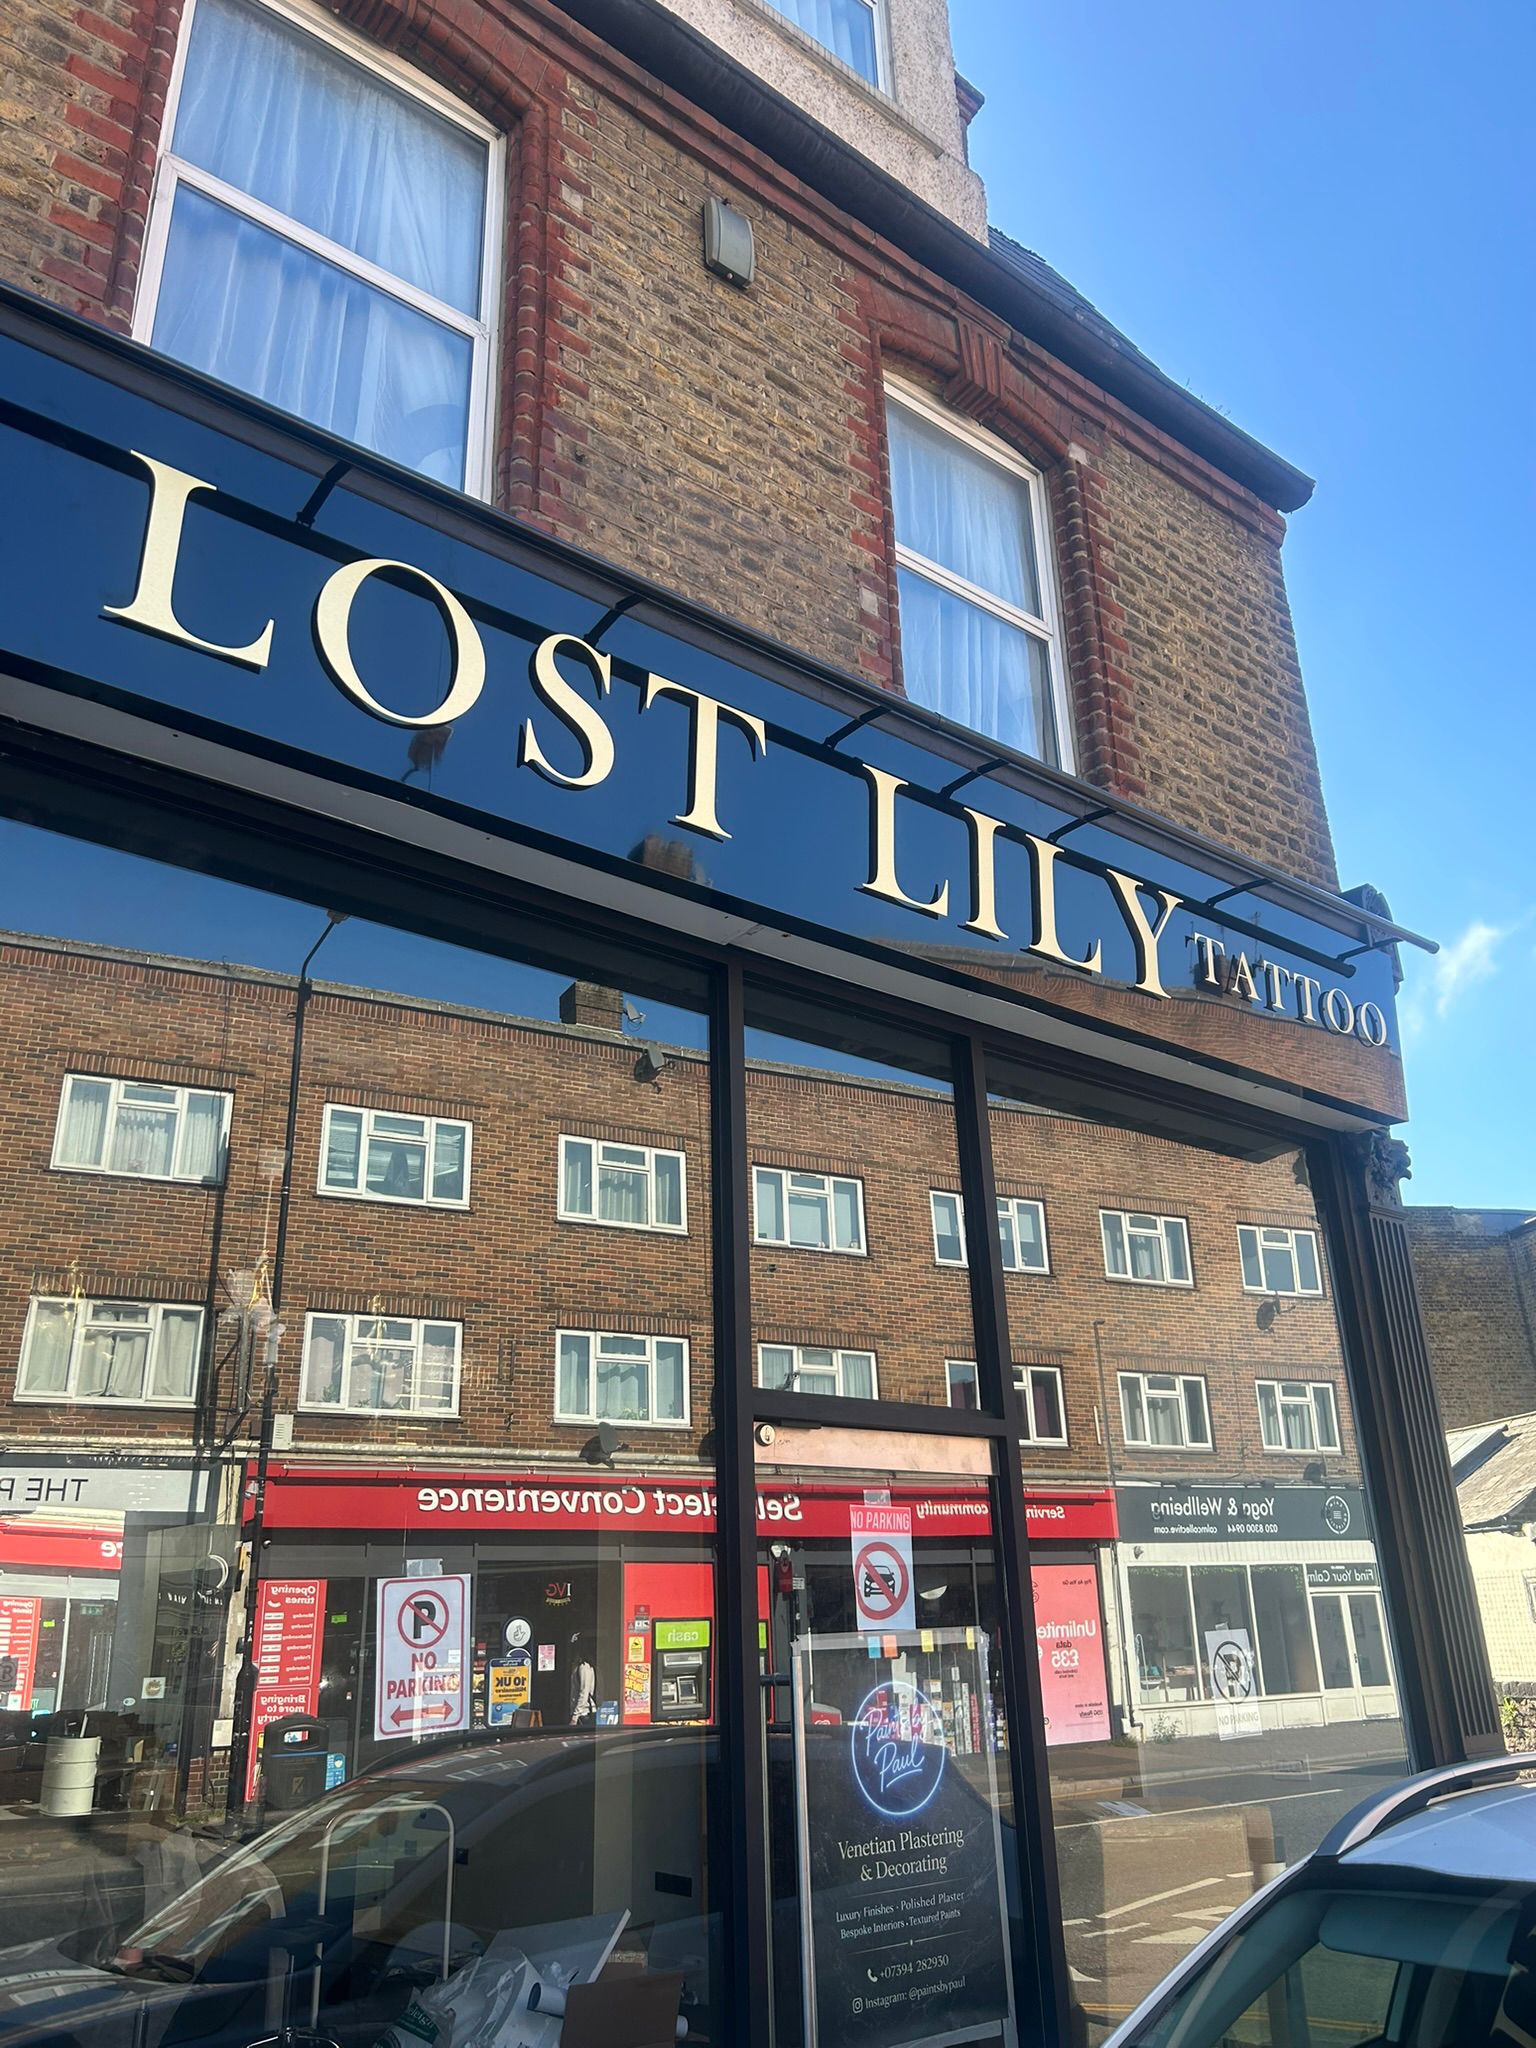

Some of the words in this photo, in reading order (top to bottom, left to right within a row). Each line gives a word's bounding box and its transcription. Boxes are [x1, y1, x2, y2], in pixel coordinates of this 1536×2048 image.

[103, 450, 766, 840] LOST
[858, 764, 1183, 999] LILY
[1192, 931, 1388, 1048] TATTOO
[850, 1510, 863, 1530] NO
[865, 1511, 911, 1531] PARKING
[411, 1651, 437, 1672] NO
[387, 1673, 461, 1700] PARKING
[874, 1732, 925, 1793] Paul
[837, 1836, 896, 1860] Venetian
[899, 1826, 965, 1851] Plastering
[860, 1863, 873, 1882] &
[876, 1854, 948, 1880] Decorating
[836, 1909, 862, 1923] Luxury
[863, 1903, 894, 1918] Finishes
[900, 1894, 936, 1911] Polished
[938, 1891, 965, 1908] Plaster
[840, 1925, 872, 1939] Bespoke
[873, 1919, 905, 1933] Interiors
[908, 1911, 940, 1927] Textured
[941, 1908, 961, 1921] Paints
[865, 1992, 907, 2010] Instagram:
[908, 1975, 966, 2001] @paintsbypaul
